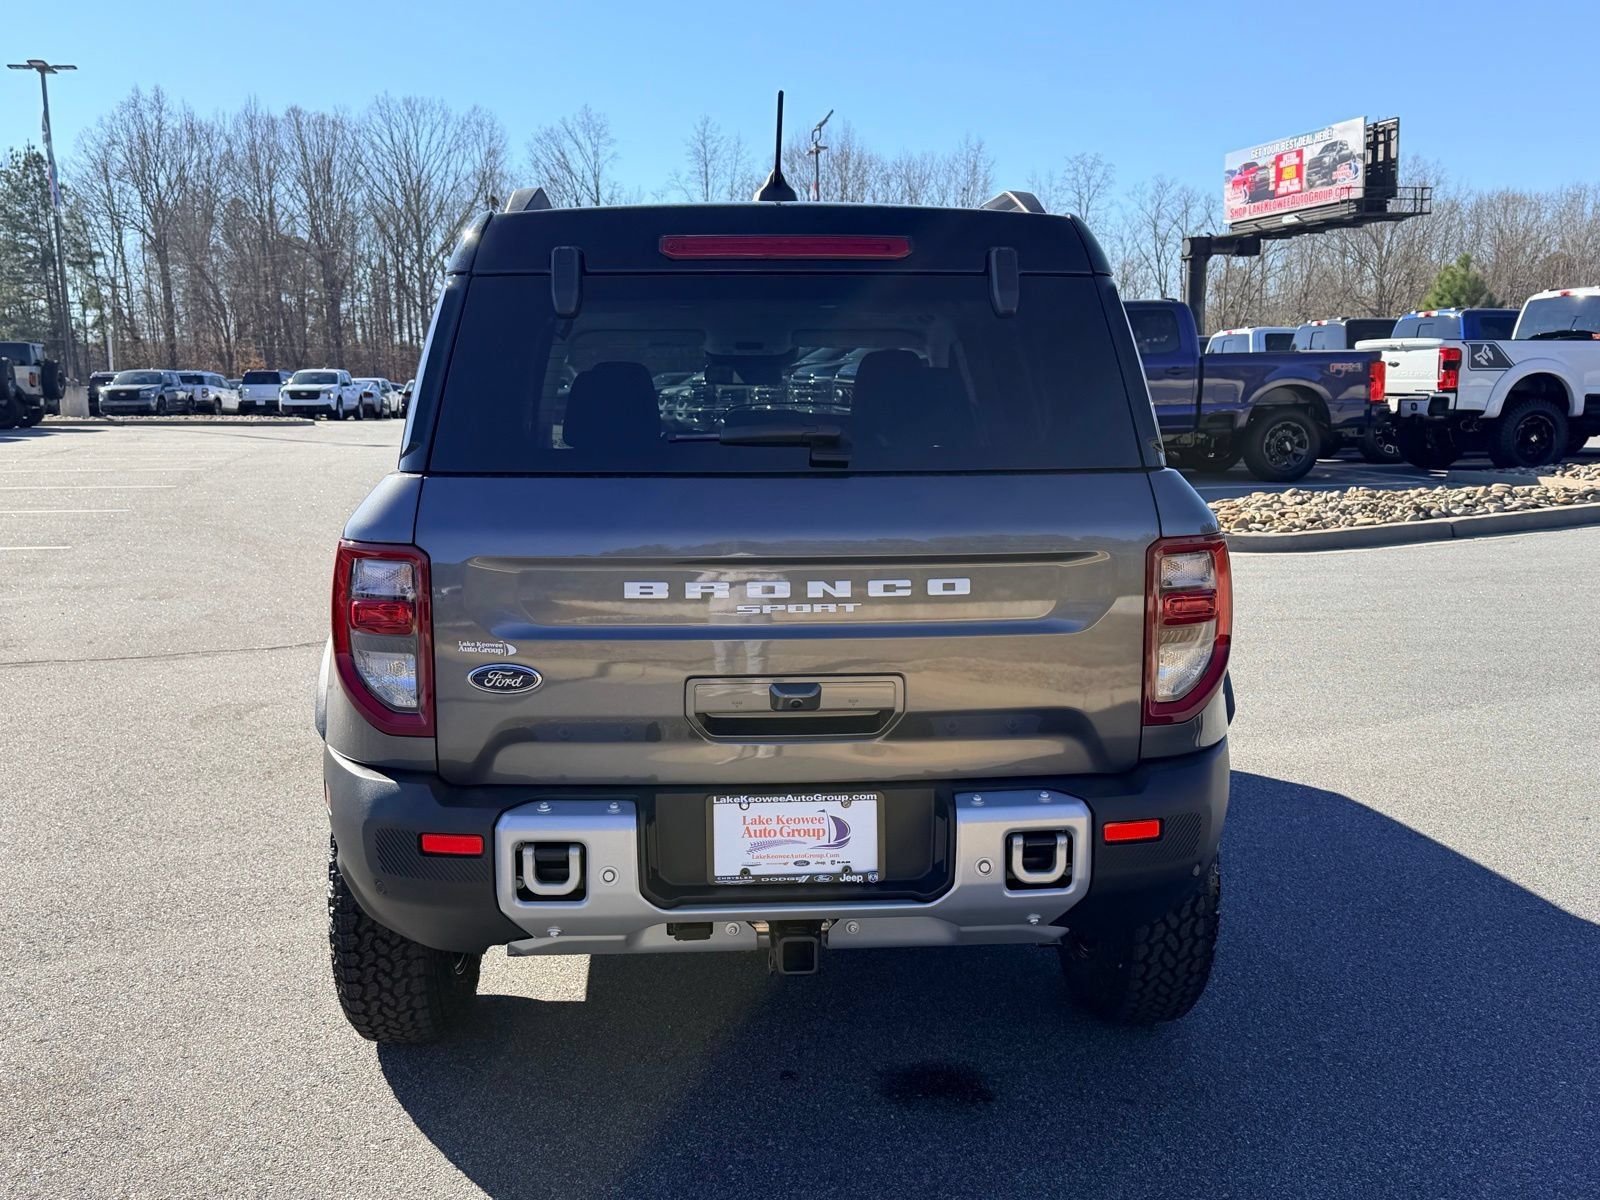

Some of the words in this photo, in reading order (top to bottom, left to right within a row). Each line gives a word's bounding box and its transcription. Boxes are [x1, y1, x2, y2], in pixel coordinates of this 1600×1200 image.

[1280, 138, 1298, 152] BEST
[1298, 134, 1313, 147] DEAL
[624, 578, 971, 599] BRONCO
[736, 603, 862, 614] SPORT
[458, 645, 477, 653] Auto
[478, 646, 504, 655] Group
[484, 670, 523, 687] Ford
[713, 793, 878, 804] LakeKeoweeAutoGroup.com
[742, 815, 773, 826] Lake
[776, 815, 825, 826] Keowee
[741, 826, 778, 839] Auto
[779, 825, 826, 841] Group
[840, 874, 863, 883] Jeep
